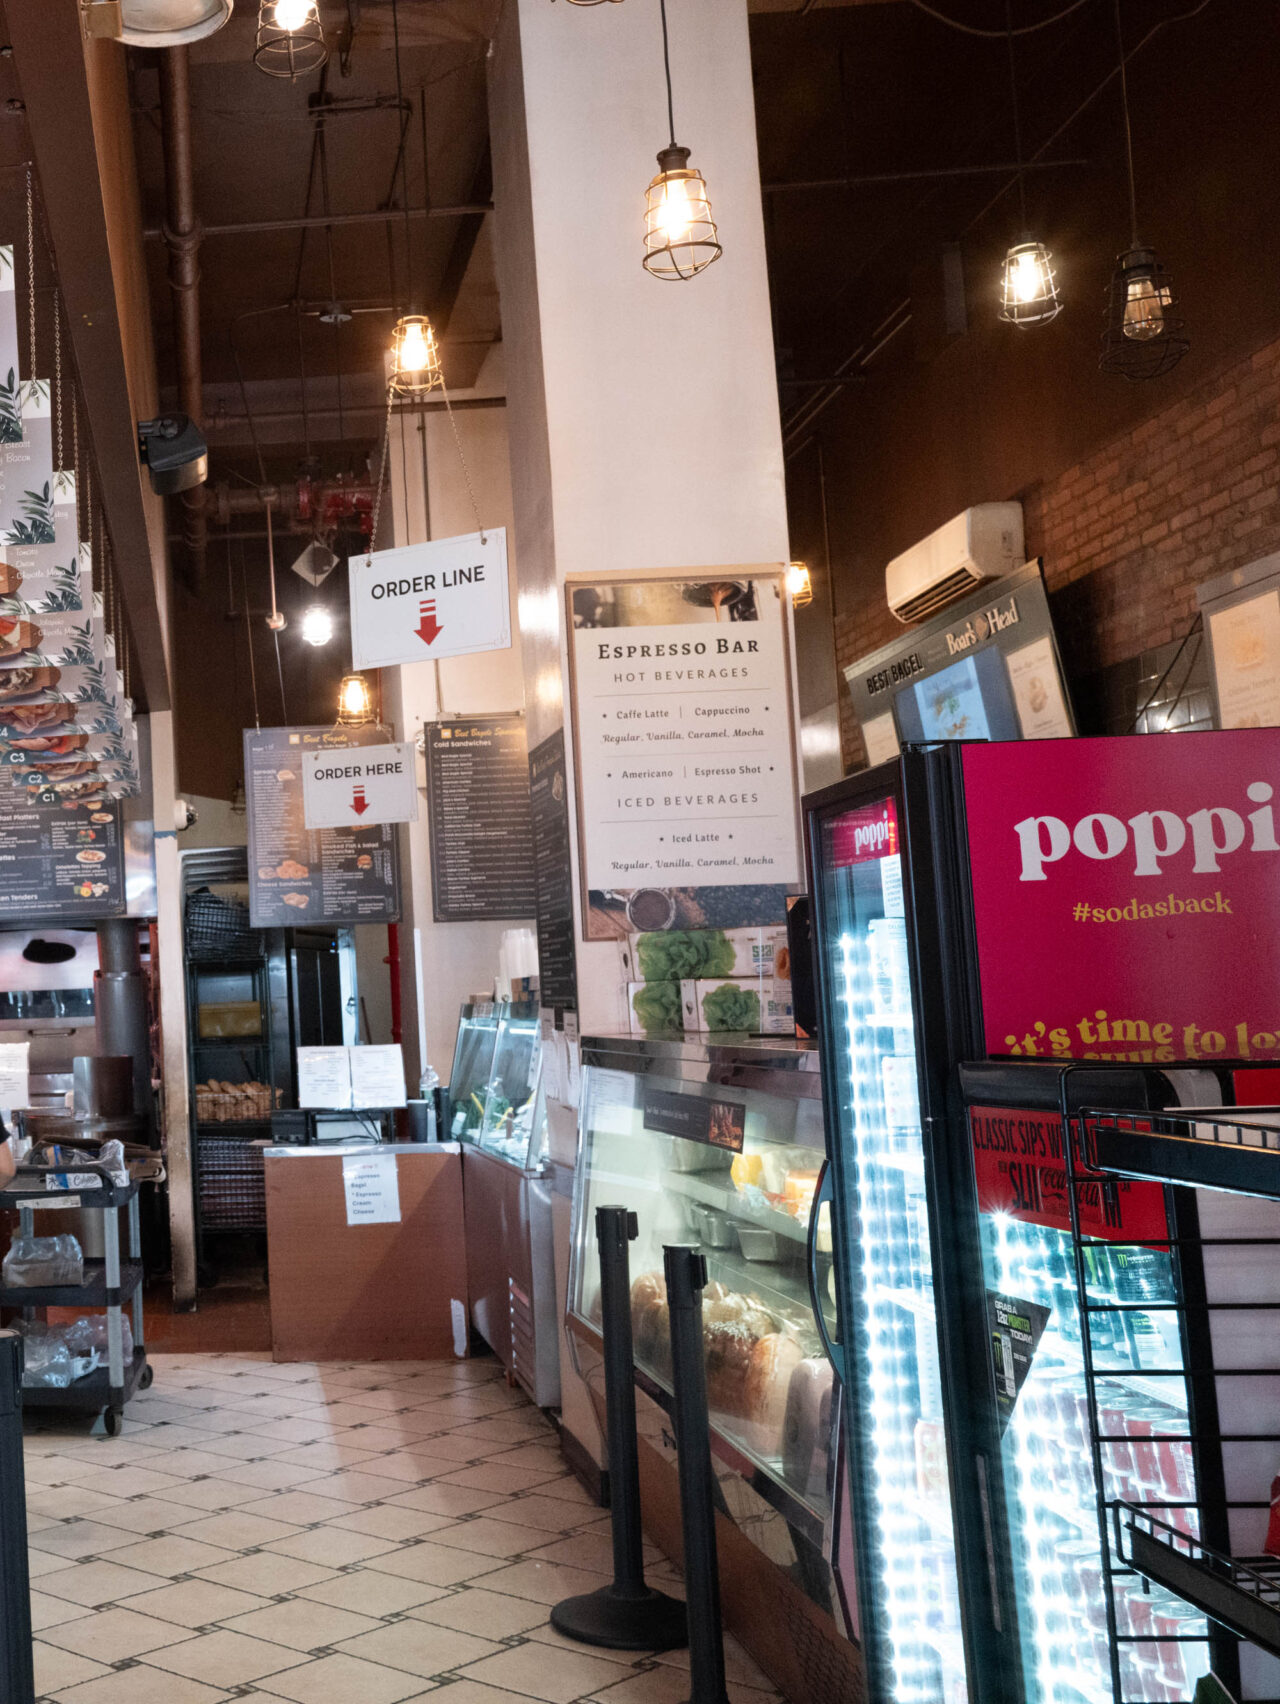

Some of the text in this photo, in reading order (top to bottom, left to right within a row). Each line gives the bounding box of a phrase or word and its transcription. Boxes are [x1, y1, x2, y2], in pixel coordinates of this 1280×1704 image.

[371, 565, 485, 600] ORDER LINE
[945, 596, 1020, 656] Boar's Head
[613, 667, 749, 683] HOT BEVERAGES
[866, 652, 924, 695] BEST BAGEL
[616, 706, 750, 719] Caffe Latte Cappuccino
[732, 727, 765, 738] Mocha
[10, 753, 26, 763] C3
[28, 774, 42, 784] C2
[314, 762, 403, 781] ORDER HERE
[621, 765, 761, 779] Americano Espresso Shot
[42, 793, 55, 802] C1
[617, 793, 759, 808] ICED BEVERAGES
[672, 833, 720, 843] Iced Latte
[854, 809, 890, 855] poppi
[1013, 781, 1280, 882] poppi
[741, 855, 774, 866] Mocha
[1072, 891, 1234, 924] #sodasback
[1076, 1009, 1174, 1045] time
[1183, 1023, 1227, 1055] to
[1235, 1022, 1280, 1057] lo
[972, 1116, 1018, 1154] CLASSIC
[1021, 1120, 1047, 1158] SIPS
